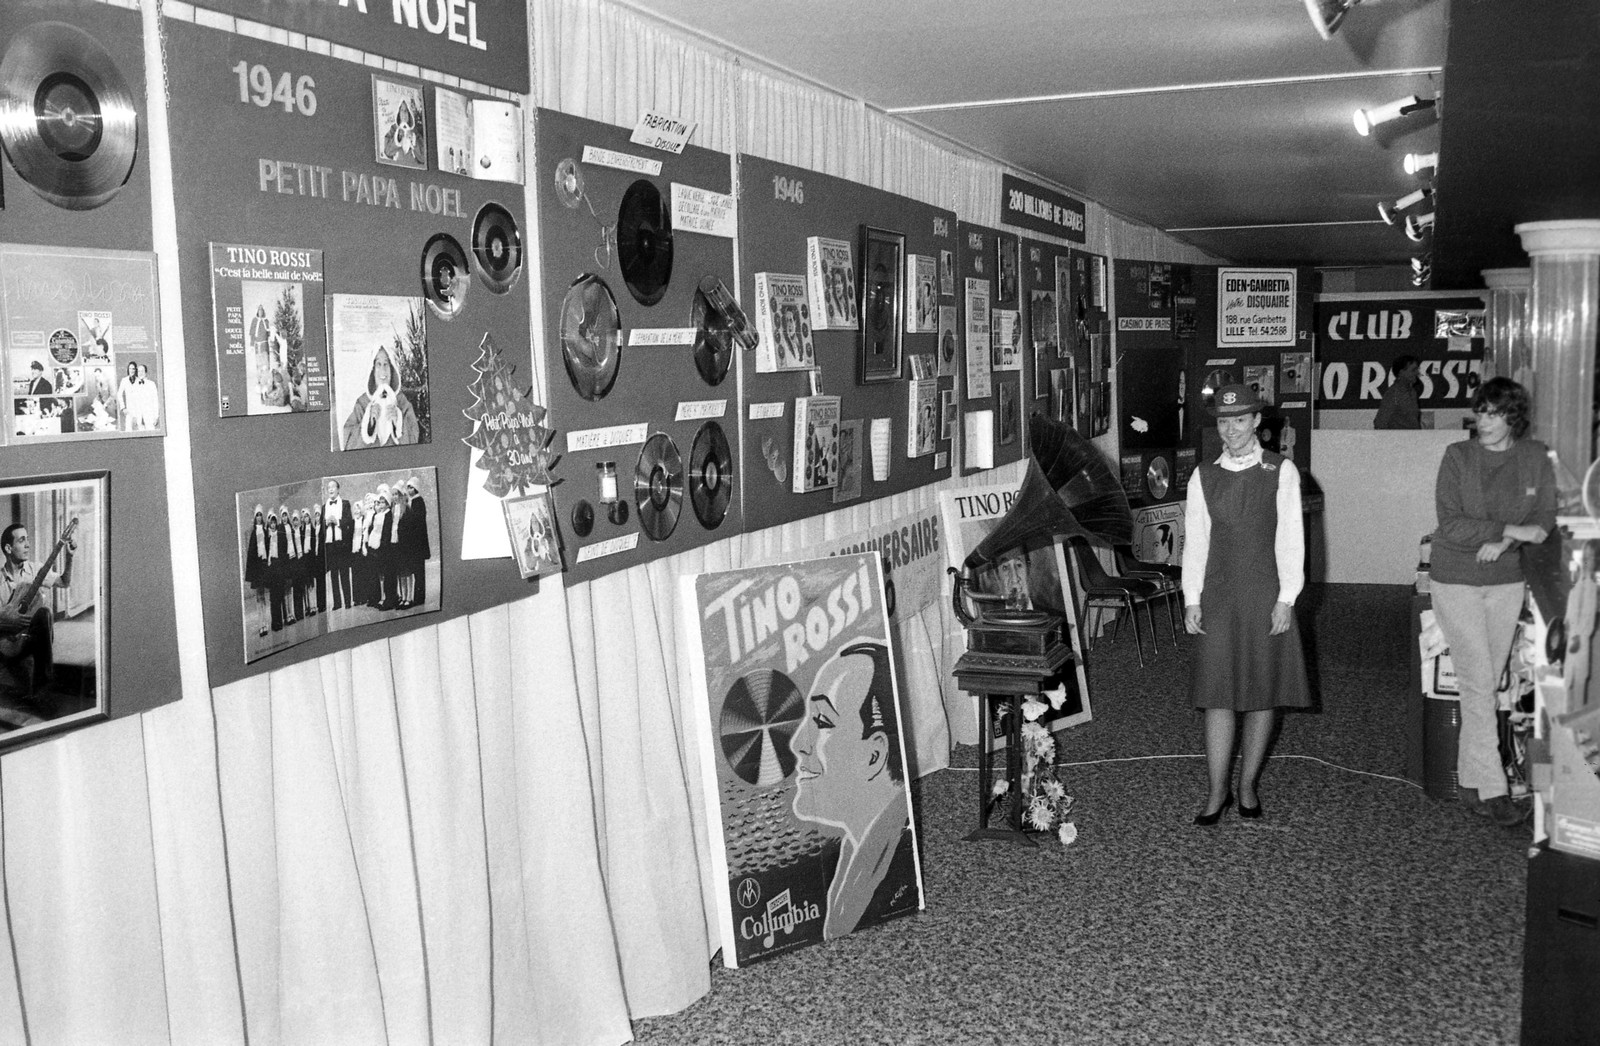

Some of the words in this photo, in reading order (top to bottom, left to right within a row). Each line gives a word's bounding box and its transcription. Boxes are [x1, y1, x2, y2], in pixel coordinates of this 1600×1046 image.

[392, 0, 487, 50] NOEL
[232, 60, 317, 116] 1946
[259, 158, 333, 199] PETIT
[342, 170, 401, 209] PAPA
[410, 181, 468, 219] NOEL
[772, 175, 804, 205] 1946
[227, 247, 267, 265] TINO
[270, 250, 311, 268] ROSSI
[252, 268, 273, 280] belle
[274, 270, 290, 280] nuit
[291, 271, 301, 281] de
[770, 283, 788, 296] TINO
[1247, 294, 1290, 310] DISQUAIRE
[1121, 318, 1143, 329] CASINO
[1145, 318, 1153, 329] DE
[1154, 318, 1171, 329] PARIS
[1226, 326, 1245, 336] LILLE
[1252, 314, 1287, 324] Gambetta
[1328, 310, 1413, 340] CLUB
[1360, 360, 1482, 399] RSSI
[507, 450, 520, 466] 30
[520, 453, 533, 465] ans
[955, 492, 1000, 518] TINO
[830, 514, 939, 574] ERSAIRE
[740, 900, 821, 940] Columbia
